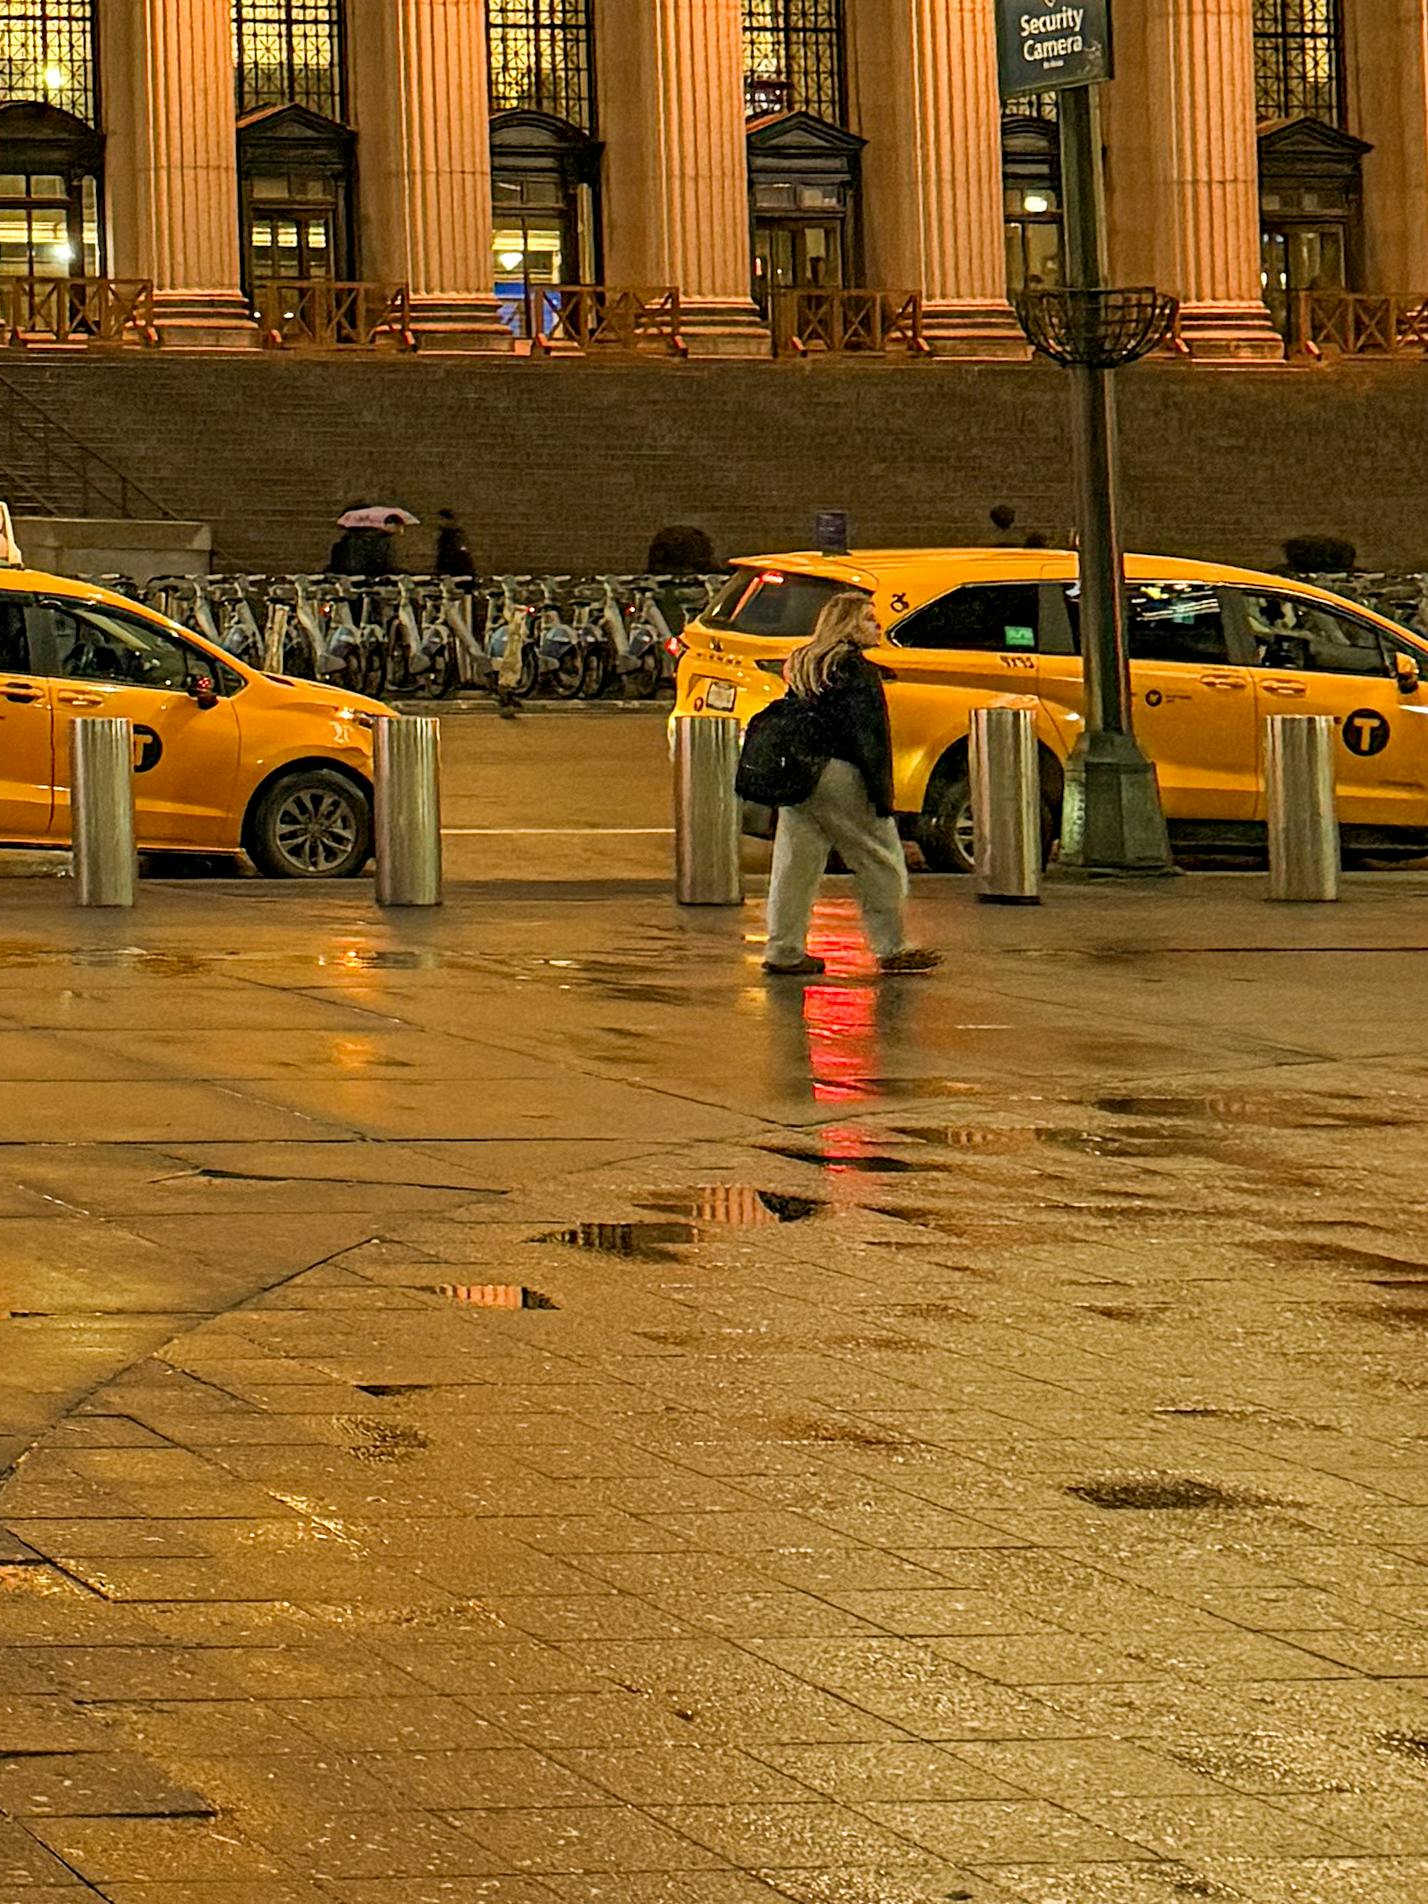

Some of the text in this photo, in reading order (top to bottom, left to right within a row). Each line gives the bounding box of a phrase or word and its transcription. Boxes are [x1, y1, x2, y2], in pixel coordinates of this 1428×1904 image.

[1020, 5, 1084, 37] Security
[1023, 35, 1083, 61] Camera
[1353, 717, 1381, 751] T
